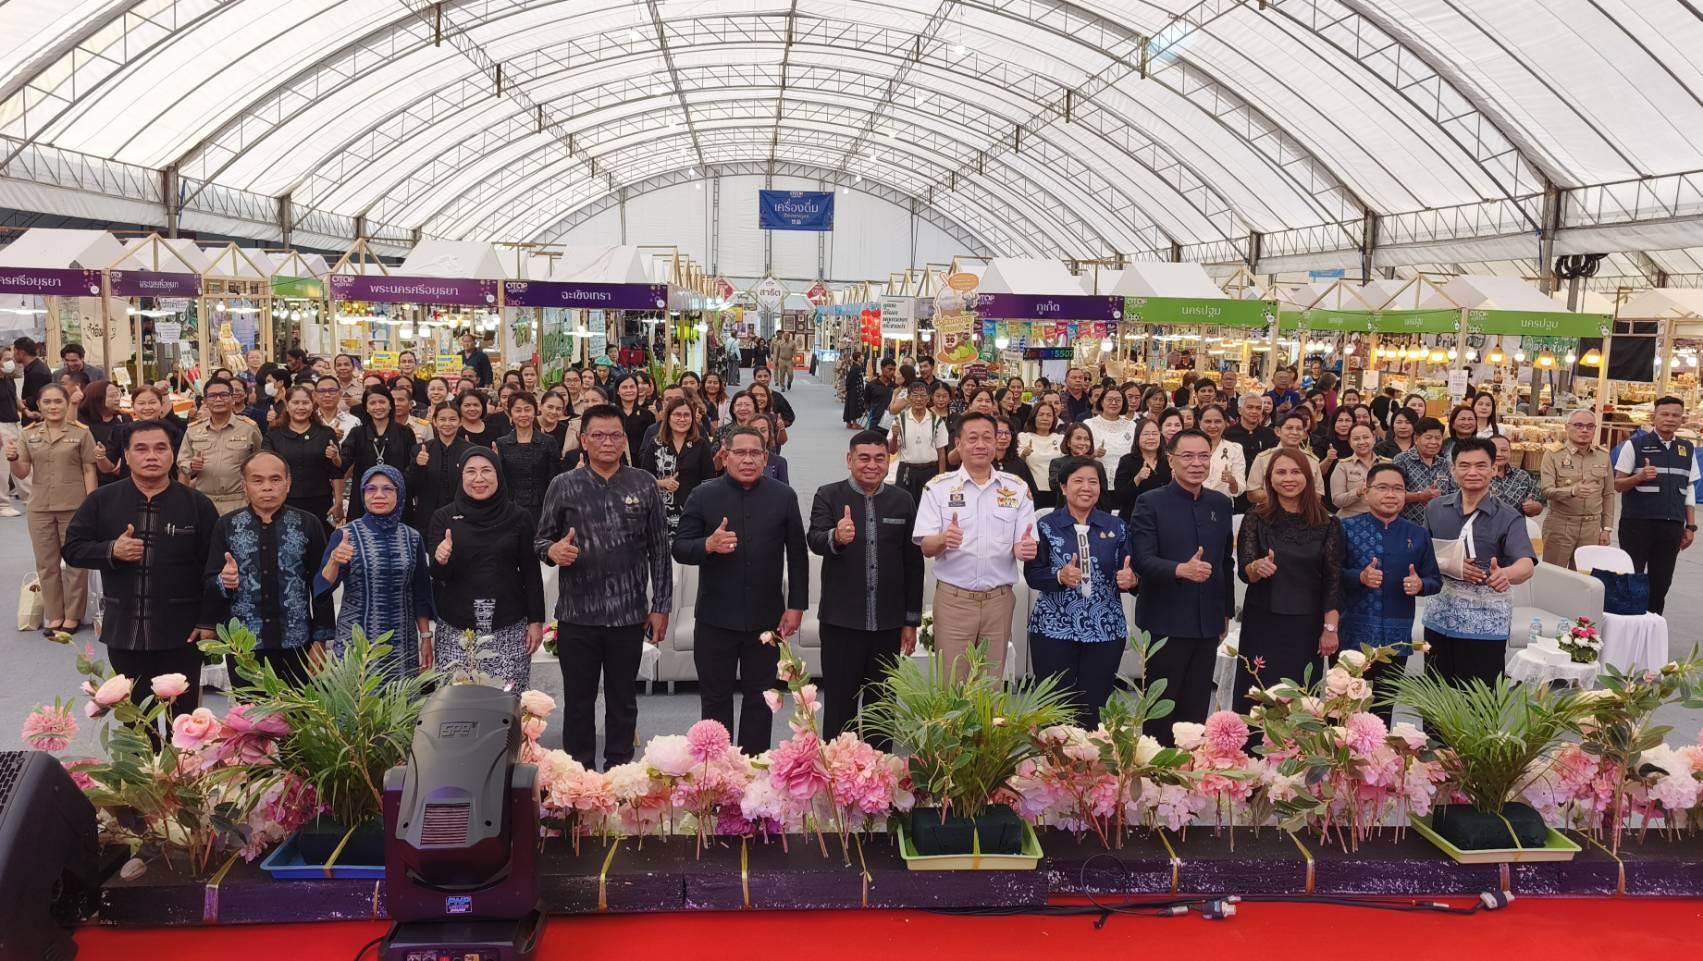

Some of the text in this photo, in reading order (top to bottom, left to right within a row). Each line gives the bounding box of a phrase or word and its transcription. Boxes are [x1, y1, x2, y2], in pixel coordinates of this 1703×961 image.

[774, 197, 819, 213] เครื่องดื่ม
[331, 275, 355, 283] OTOP
[369, 284, 459, 299] พระนครศรีอยุธยา
[561, 289, 612, 301] ฉะเชิงเทรา
[1036, 300, 1060, 315] ภูเก็ต
[1181, 305, 1221, 318] นครปฐม
[1521, 318, 1560, 331] นครปฐม
